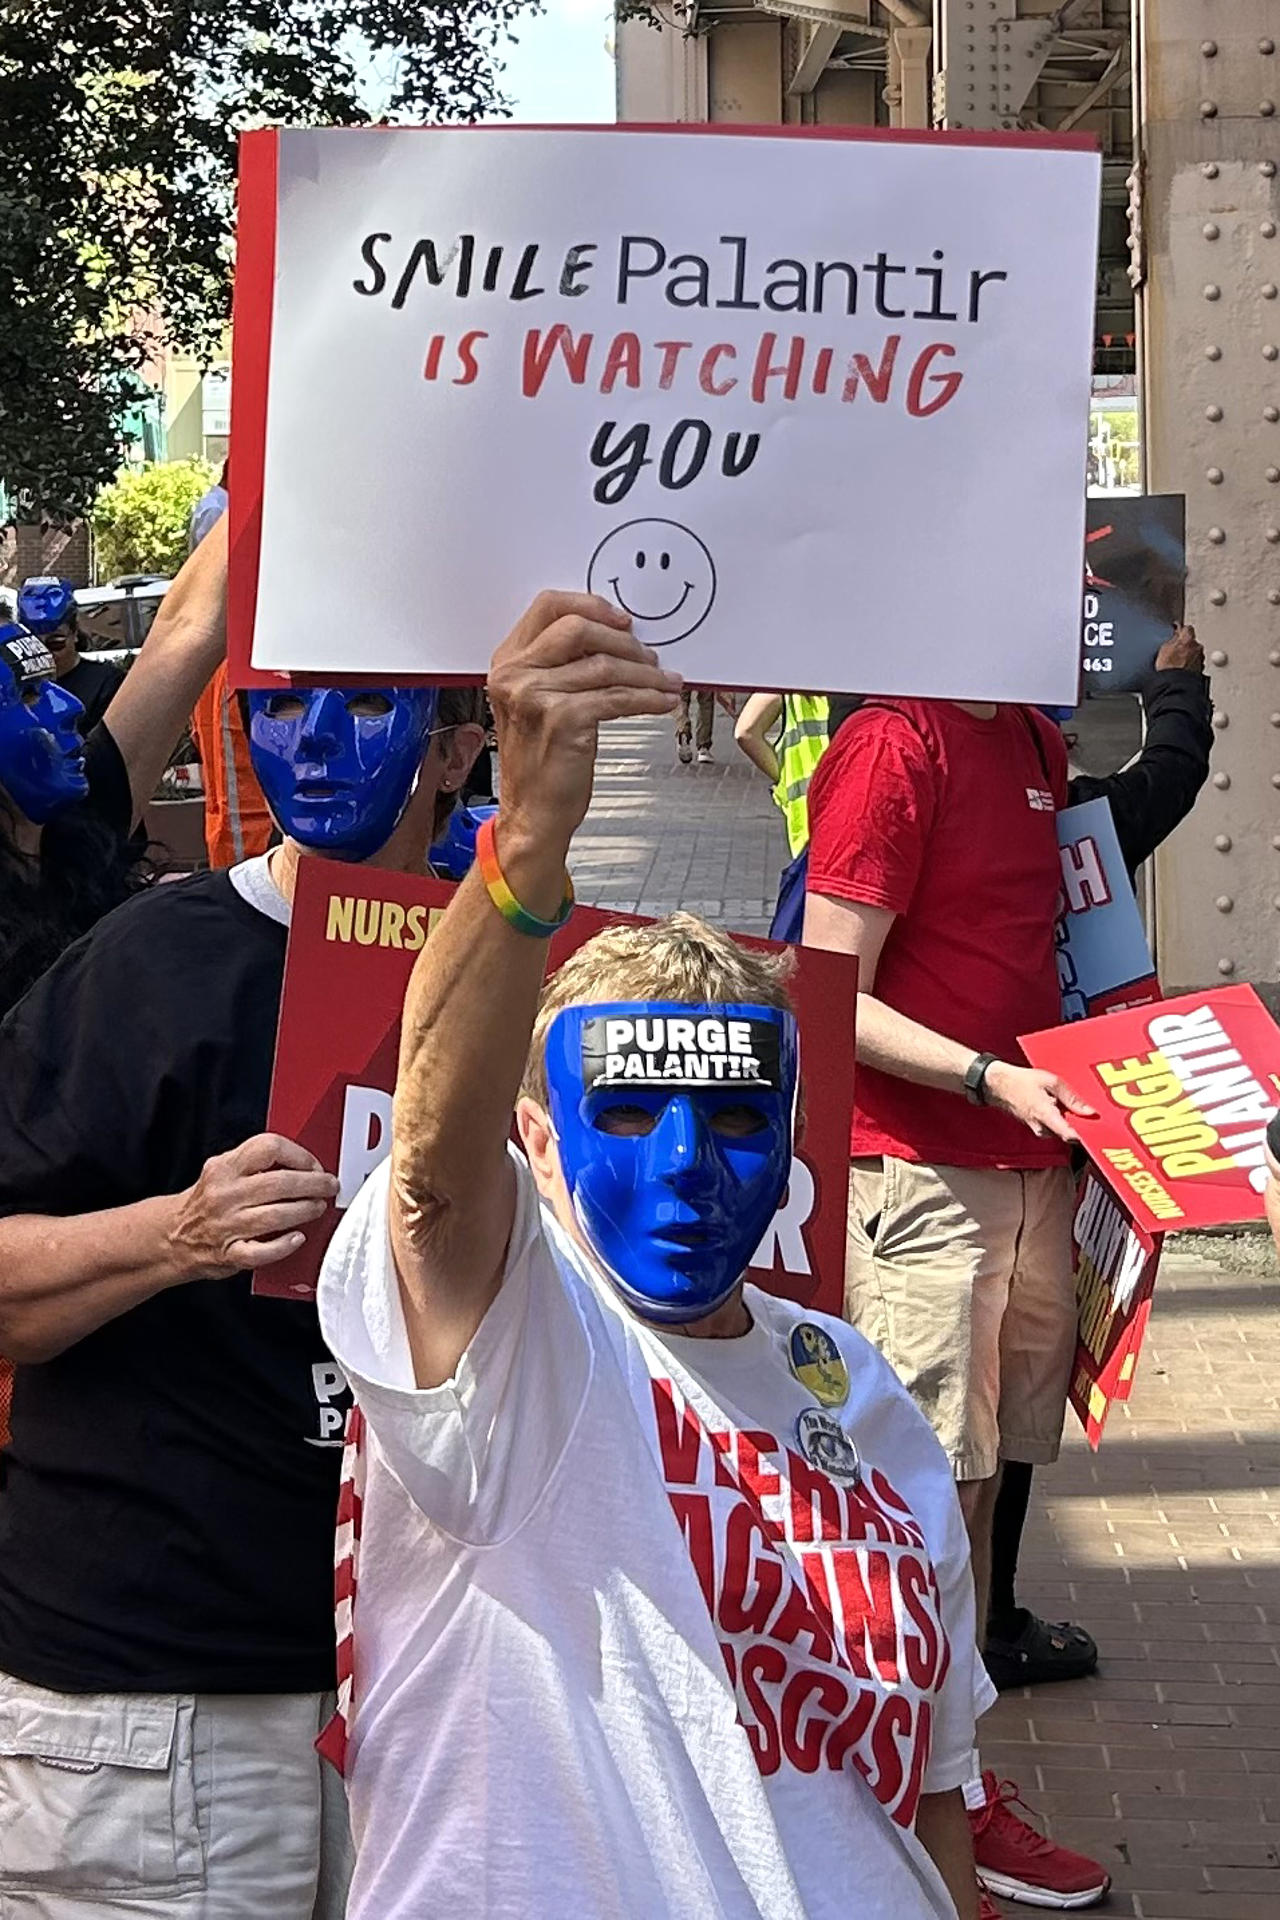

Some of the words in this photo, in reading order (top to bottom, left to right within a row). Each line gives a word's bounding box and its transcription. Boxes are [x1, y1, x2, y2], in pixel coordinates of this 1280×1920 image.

[352, 232, 598, 309] SMILE
[616, 235, 1008, 322] Palantir
[421, 330, 489, 385] IS
[521, 323, 964, 417] WATCHING
[605, 1018, 752, 1054] PURGE
[605, 1053, 760, 1079] PALANTIR
[1096, 1049, 1239, 1179] PURGE
[1101, 1148, 1145, 1171] SAY
[1122, 1170, 1186, 1220] NURSES
